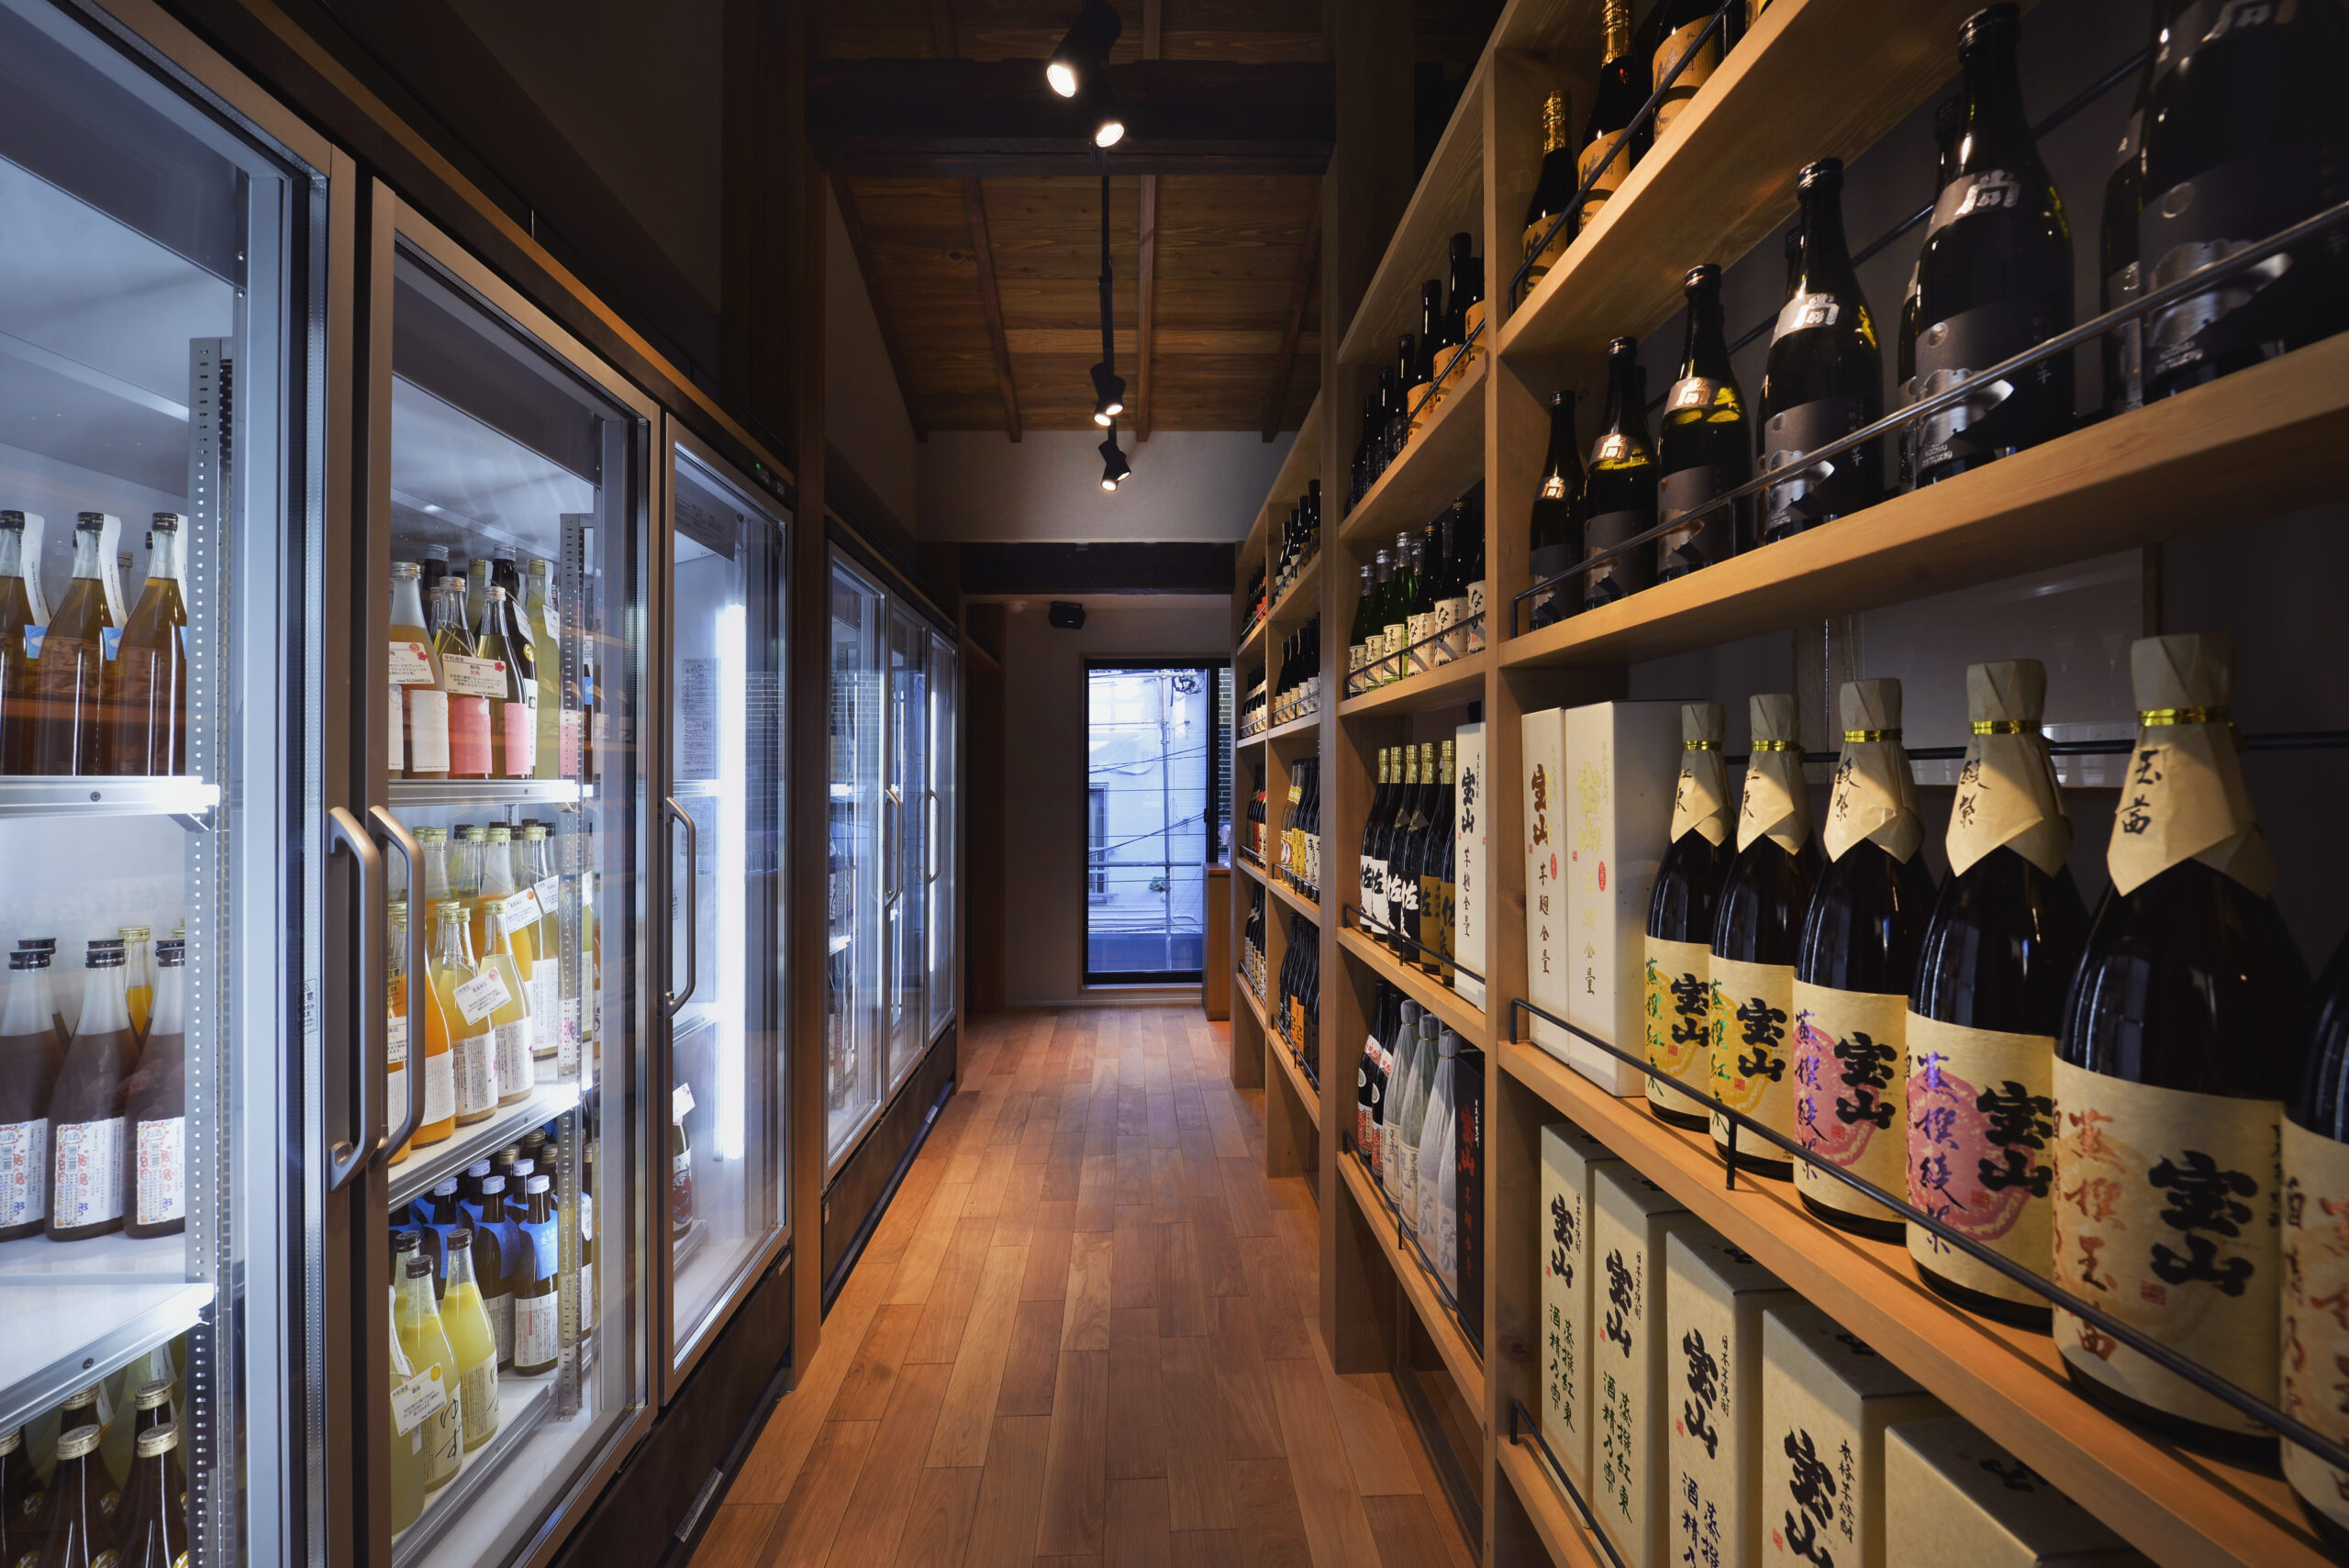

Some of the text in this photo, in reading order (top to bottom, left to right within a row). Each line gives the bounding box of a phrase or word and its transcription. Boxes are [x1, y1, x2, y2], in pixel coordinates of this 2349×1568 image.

[1531, 763, 1552, 846] 宝山
[1736, 997, 1787, 1082] 宝山
[1834, 1031, 1898, 1129] 宝山
[1976, 1081, 2053, 1198] 宝山
[1551, 1193, 1575, 1288] 宝山
[2148, 1150, 2258, 1297] 宝山
[1606, 1248, 1632, 1359] 宝山
[1682, 1328, 1719, 1460] 宝山
[1784, 1427, 1836, 1568] 宝山
